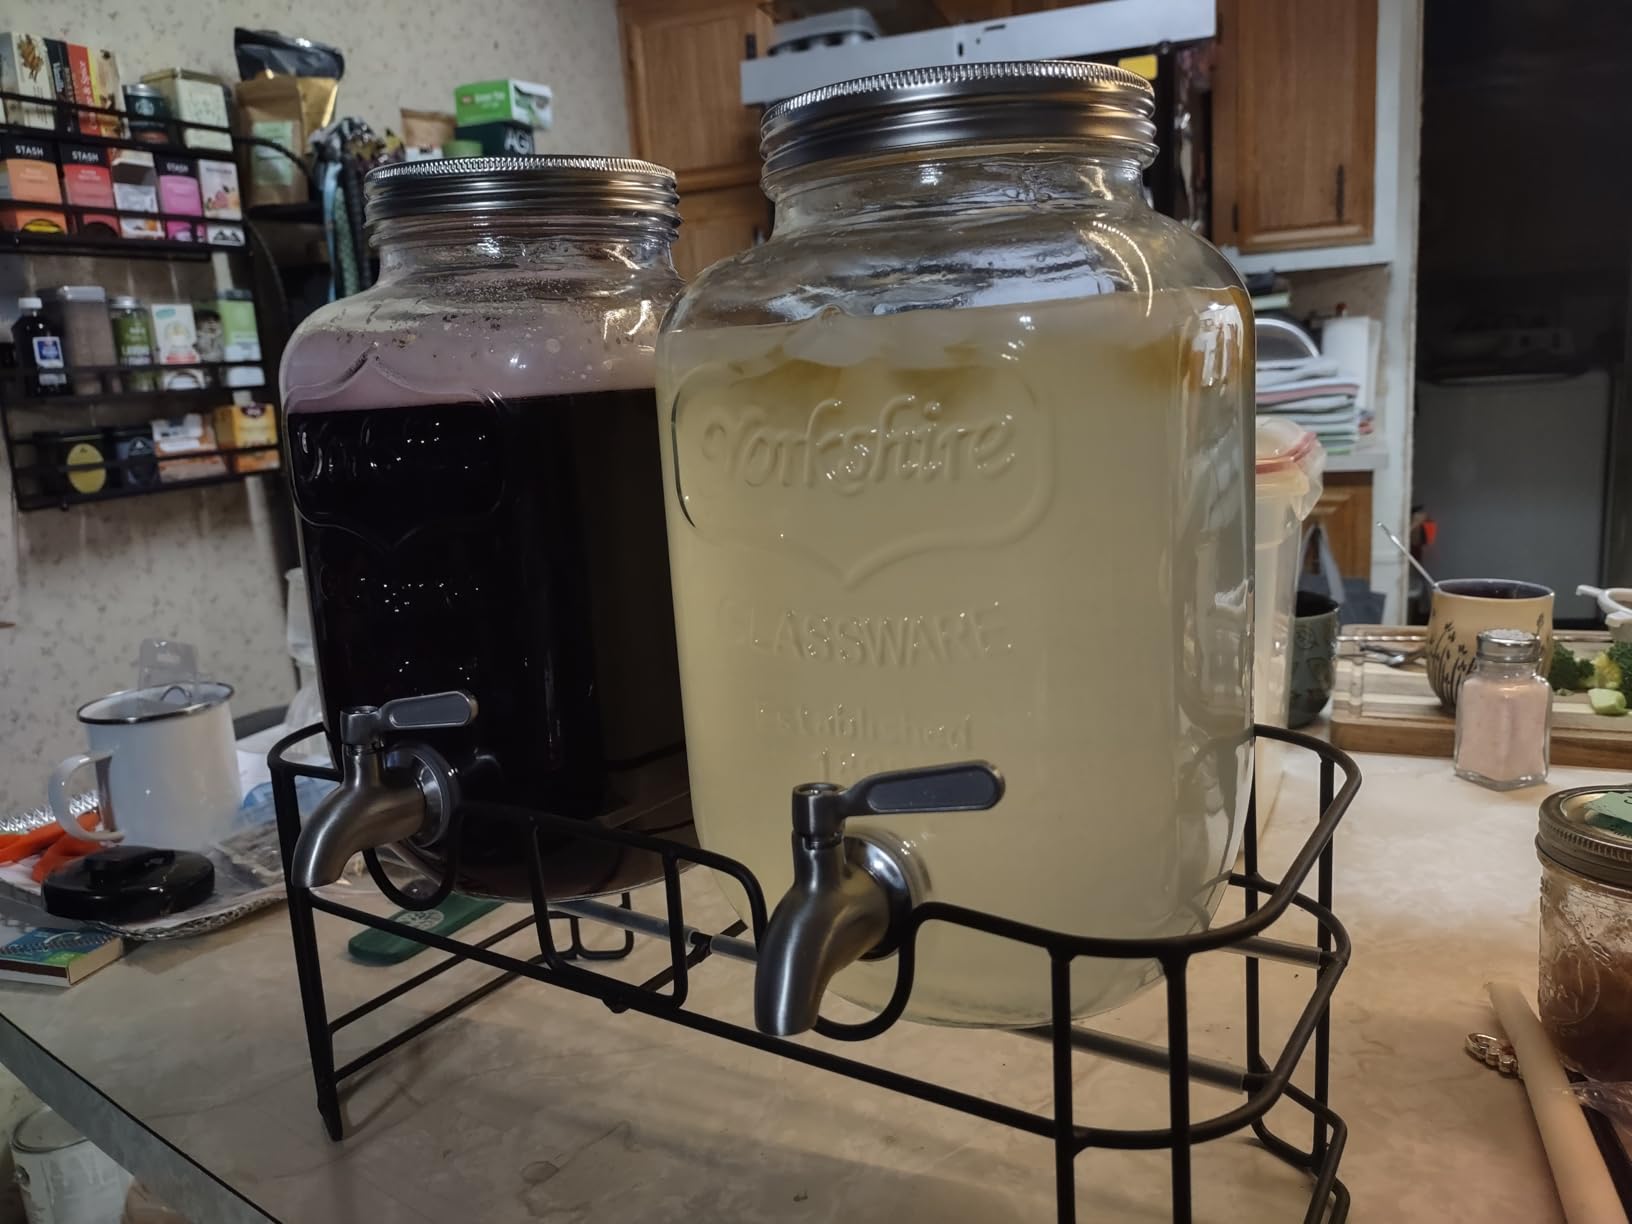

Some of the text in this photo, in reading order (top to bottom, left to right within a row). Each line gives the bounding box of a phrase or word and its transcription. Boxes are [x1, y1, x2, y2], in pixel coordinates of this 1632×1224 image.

[15, 144, 44, 157] STASH
[71, 150, 99, 162] STASH
[701, 394, 1016, 496] Yorkshire
